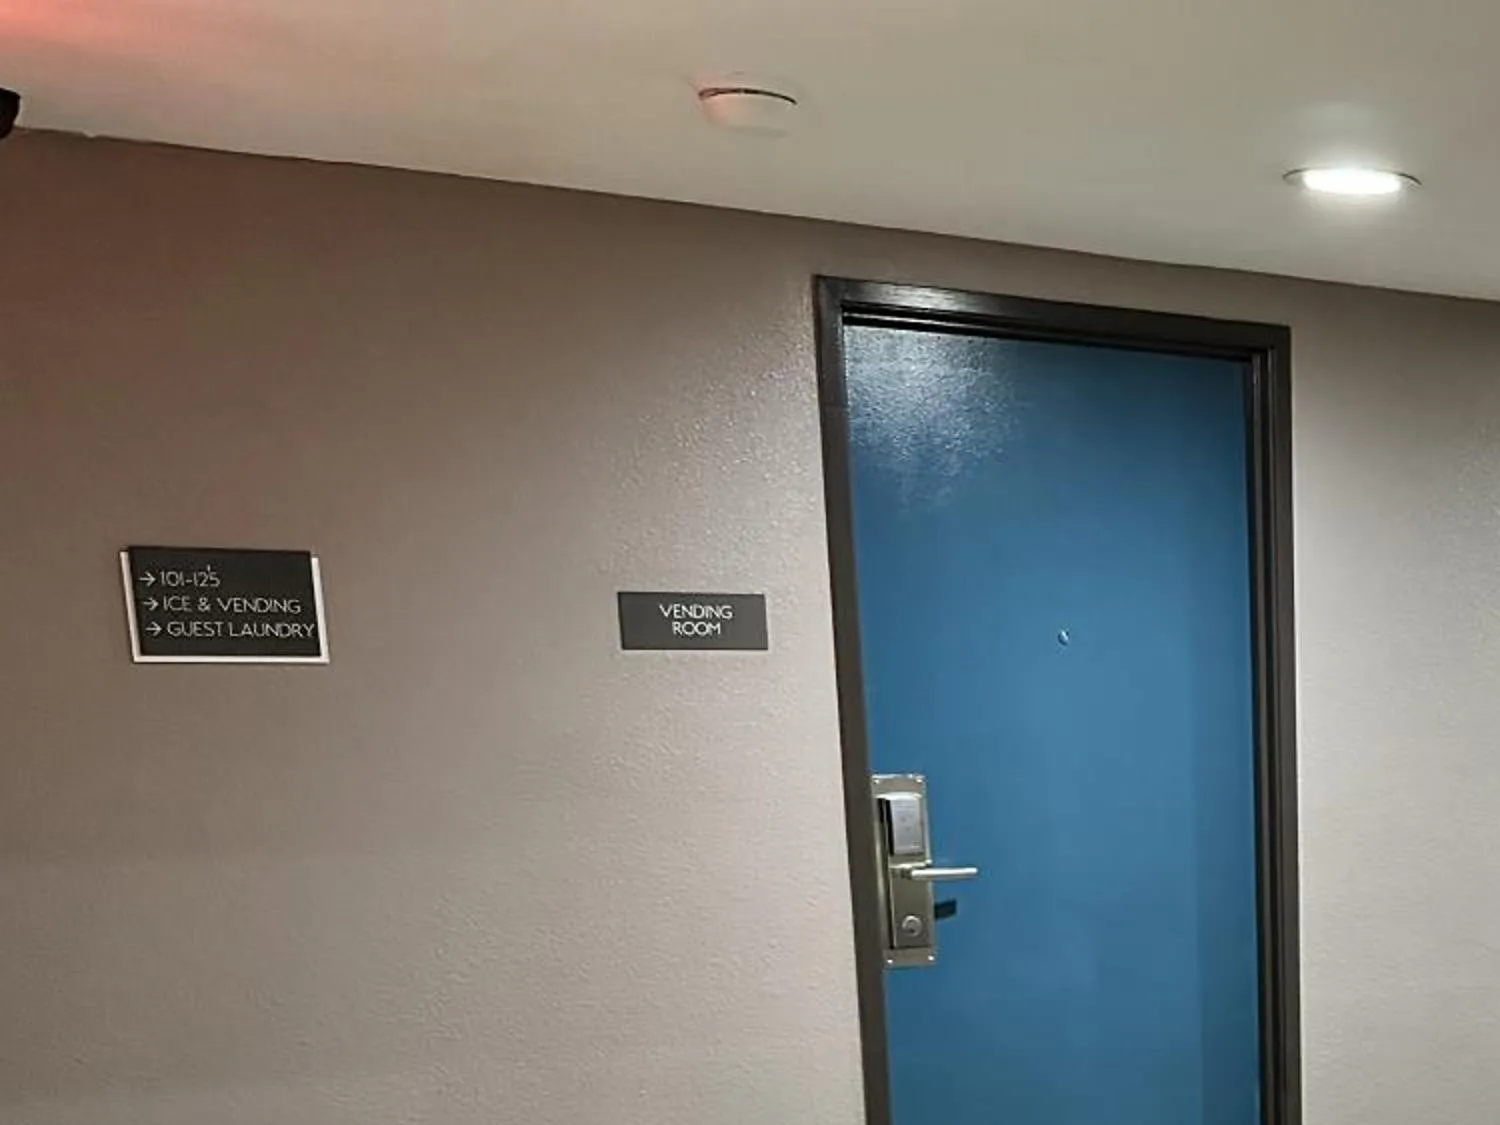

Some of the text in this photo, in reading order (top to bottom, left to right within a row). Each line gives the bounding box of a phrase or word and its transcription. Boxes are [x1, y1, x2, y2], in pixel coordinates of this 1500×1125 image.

[159, 570, 221, 587] 101-125
[163, 596, 301, 615] ICE & VENDING
[659, 604, 733, 620] VENDING
[166, 621, 316, 638] GUEST LAUNDRY
[672, 621, 721, 636] ROOM
